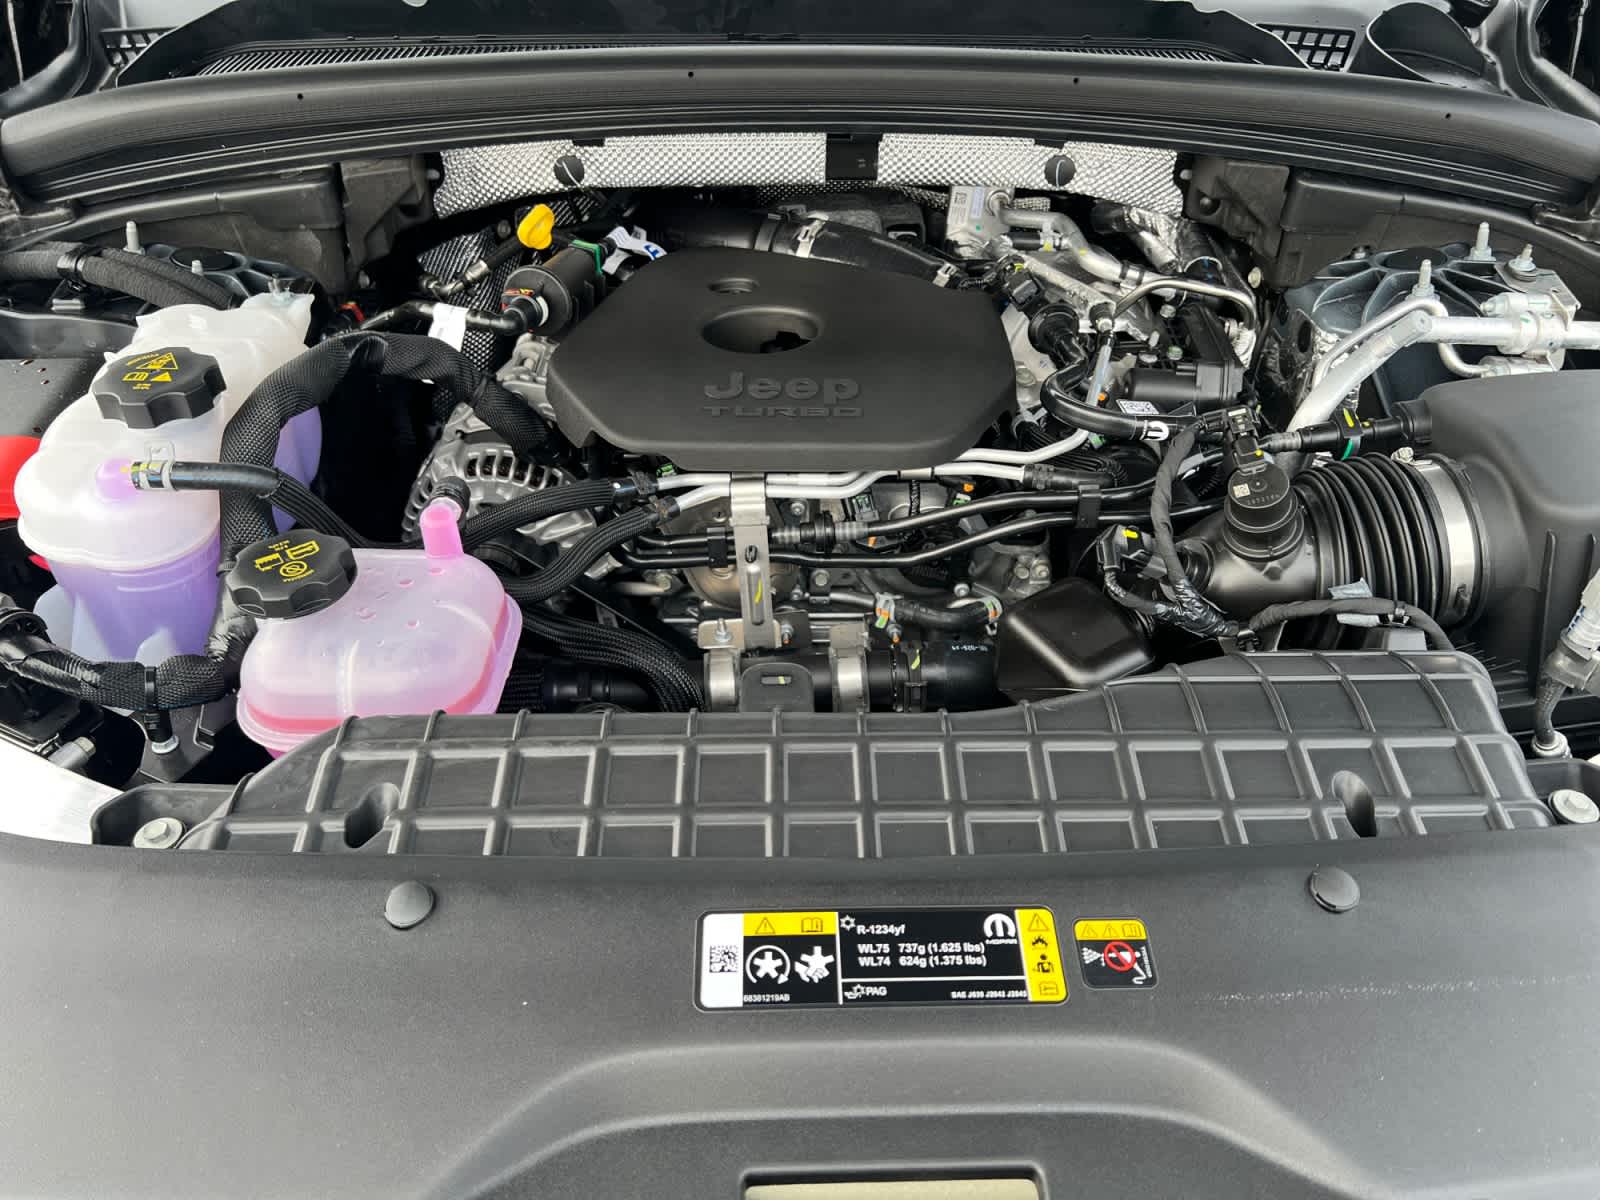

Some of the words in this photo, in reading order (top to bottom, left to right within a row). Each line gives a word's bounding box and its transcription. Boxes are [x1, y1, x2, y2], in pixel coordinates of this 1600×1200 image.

[704, 370, 861, 405] Jeep
[703, 407, 864, 417] TURBO
[857, 924, 905, 936] R-1234yf
[857, 943, 890, 954] WL75
[898, 943, 926, 955] 737g
[927, 942, 962, 955] (1.625
[963, 942, 985, 954] lbs)
[858, 956, 891, 967] WL74
[899, 956, 927, 968] 624g
[928, 955, 963, 968] (1.375
[965, 955, 987, 967] lbs)
[866, 986, 888, 996] PAG
